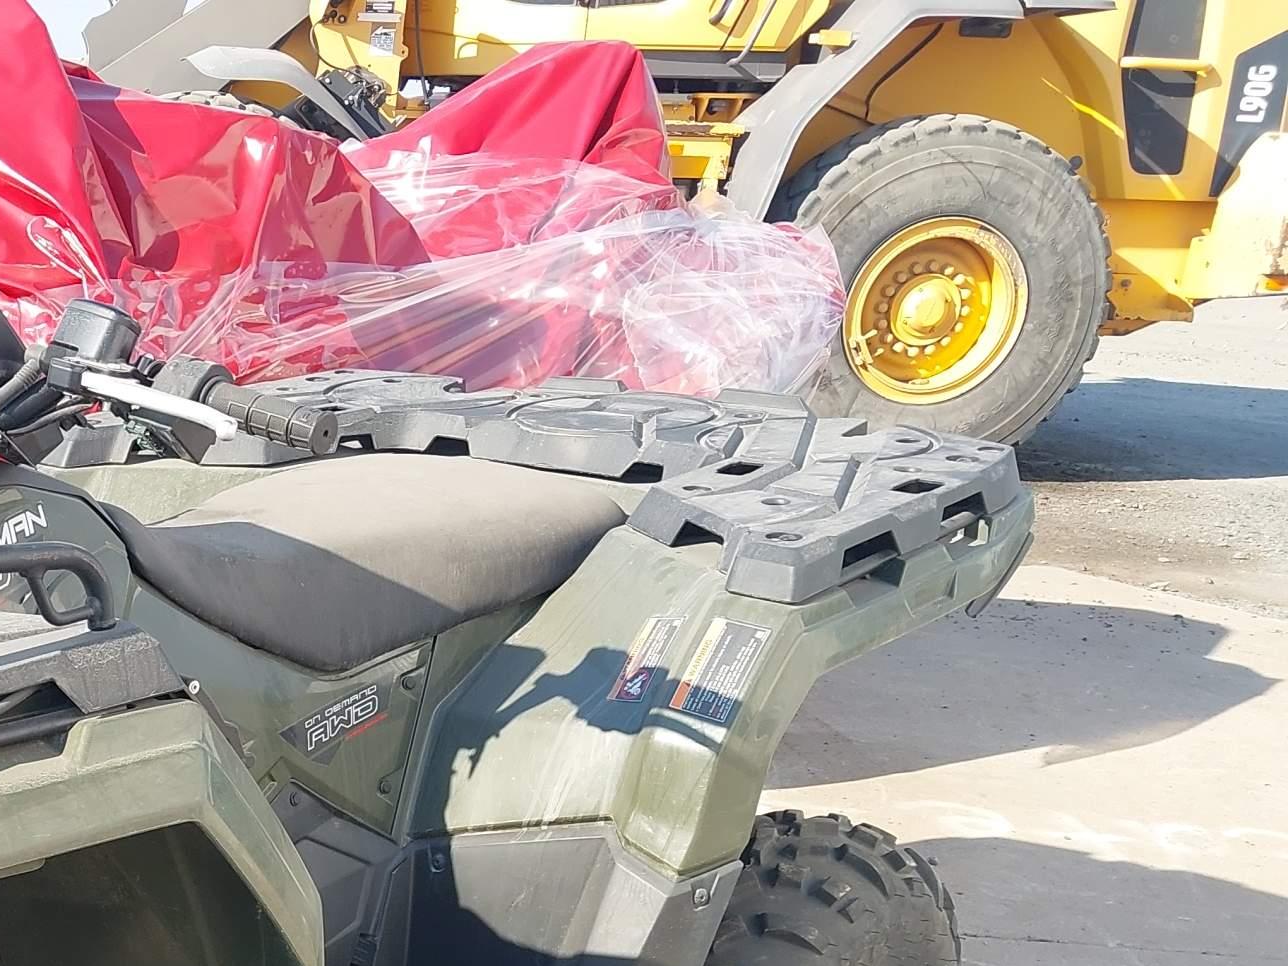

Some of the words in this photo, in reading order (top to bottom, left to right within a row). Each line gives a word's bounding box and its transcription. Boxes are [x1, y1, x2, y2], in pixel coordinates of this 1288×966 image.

[1235, 64, 1278, 123] L90G
[307, 694, 379, 752] AWD
[324, 684, 377, 717] DEMAND
